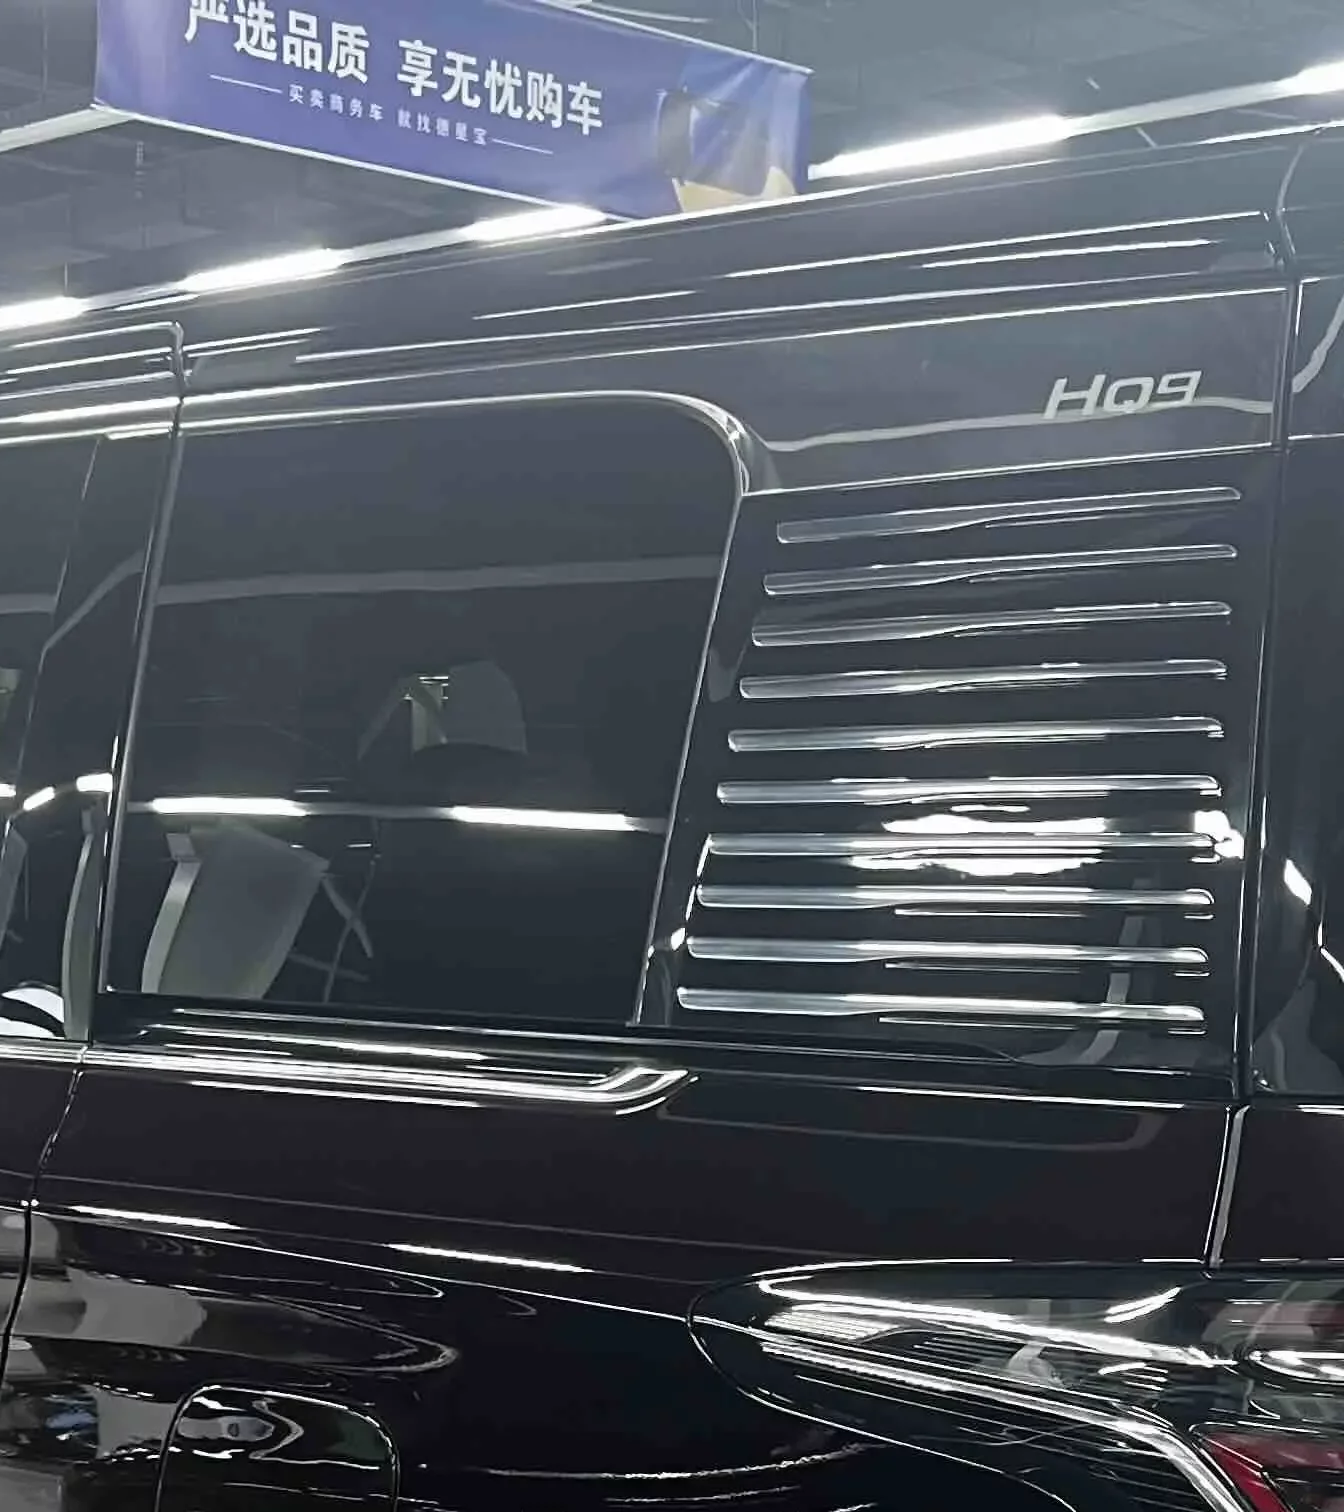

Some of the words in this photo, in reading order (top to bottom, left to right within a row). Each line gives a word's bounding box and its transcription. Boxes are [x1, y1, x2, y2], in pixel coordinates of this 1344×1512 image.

[184, 0, 370, 84] 严选品质
[396, 38, 603, 136] 享无忧购车
[1042, 369, 1203, 420] HQ9
